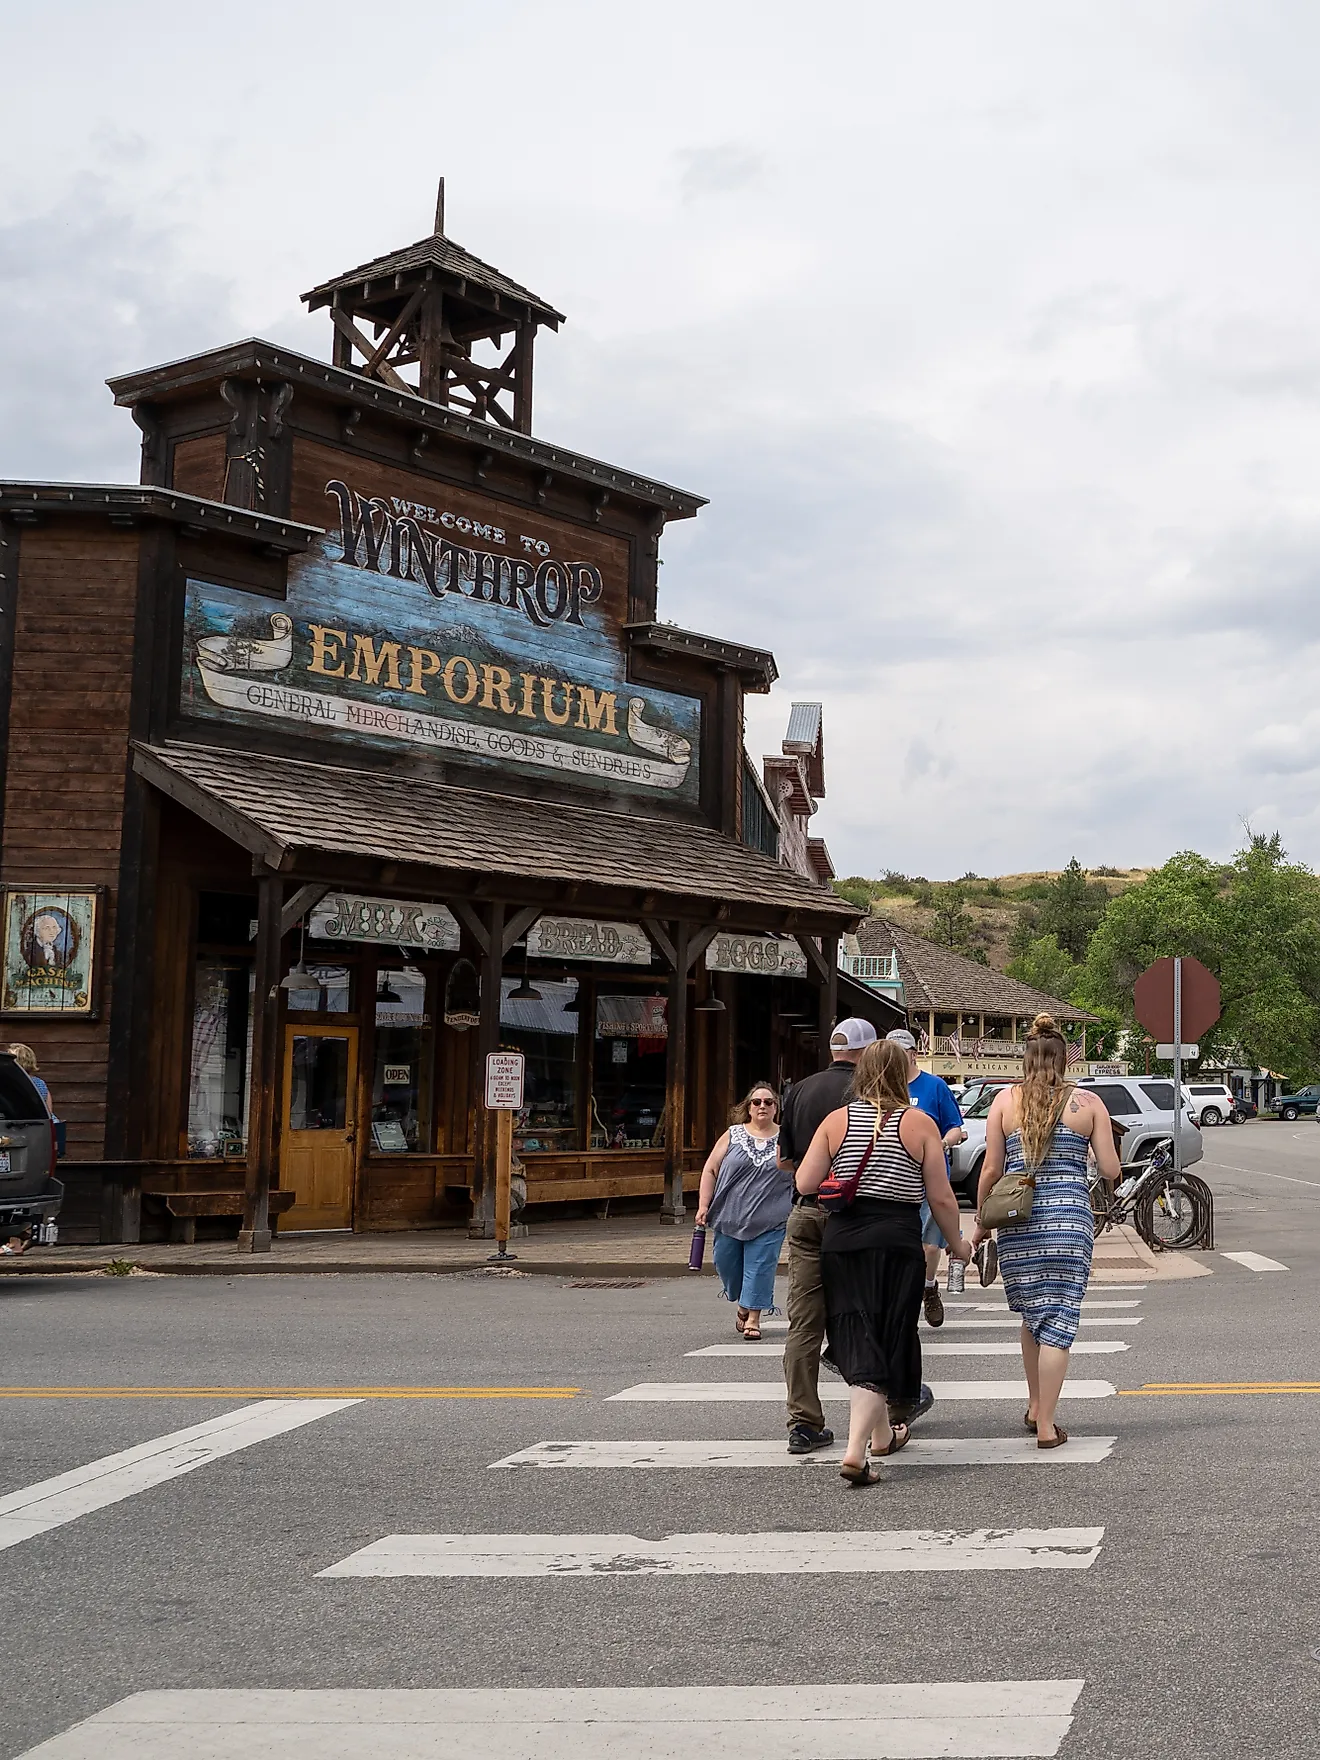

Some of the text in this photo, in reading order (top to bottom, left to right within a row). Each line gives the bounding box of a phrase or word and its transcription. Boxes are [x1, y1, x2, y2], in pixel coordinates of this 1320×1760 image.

[390, 496, 551, 558] WELCOME TO
[324, 479, 603, 628] WINTHROP
[307, 623, 619, 736] EMPORIUM
[246, 684, 337, 721] GENERAL
[487, 733, 545, 762] GOODS
[551, 744, 565, 765] &
[572, 749, 652, 781] SUNDRIES
[324, 898, 423, 943] MILK
[537, 920, 622, 957] BREAD
[27, 966, 68, 979] CASH
[716, 937, 779, 971] EGGS
[385, 1068, 409, 1080] OPEN
[492, 1058, 519, 1066] LOADING
[967, 1062, 1008, 1071] MEXICAN
